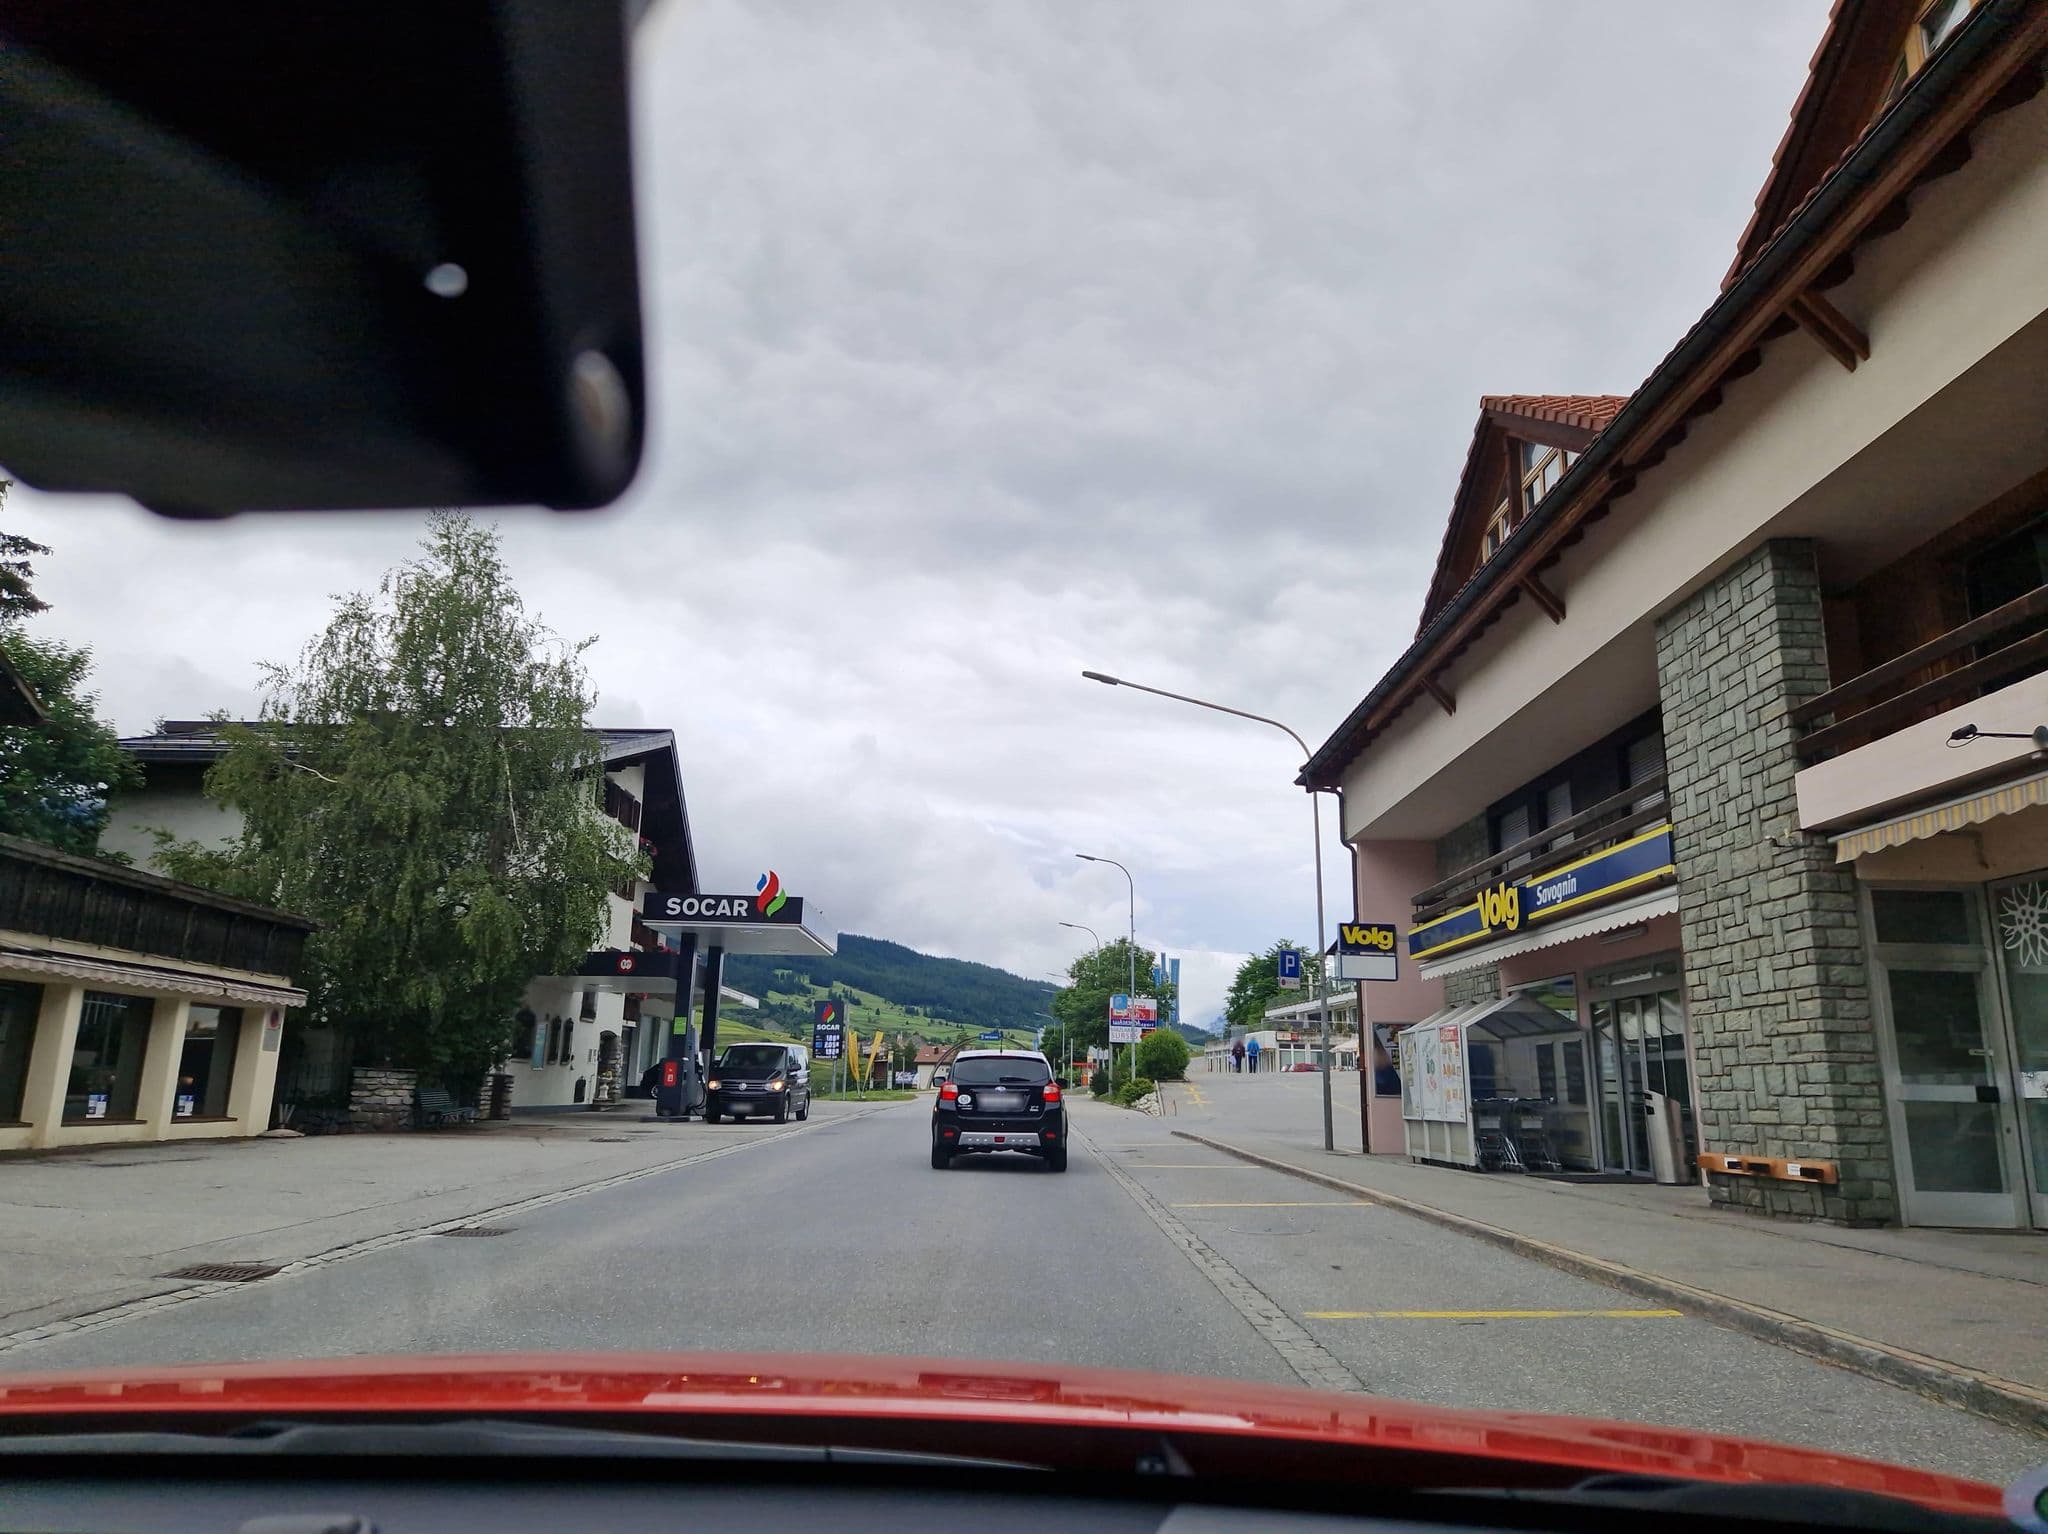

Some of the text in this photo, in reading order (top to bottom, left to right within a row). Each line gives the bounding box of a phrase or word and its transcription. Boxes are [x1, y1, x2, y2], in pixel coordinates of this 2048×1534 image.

[1536, 874, 1577, 906] Savognin
[665, 897, 749, 917] SOCAR
[1477, 881, 1520, 931] Volg
[1342, 925, 1394, 951] Volg
[1285, 954, 1295, 974] P
